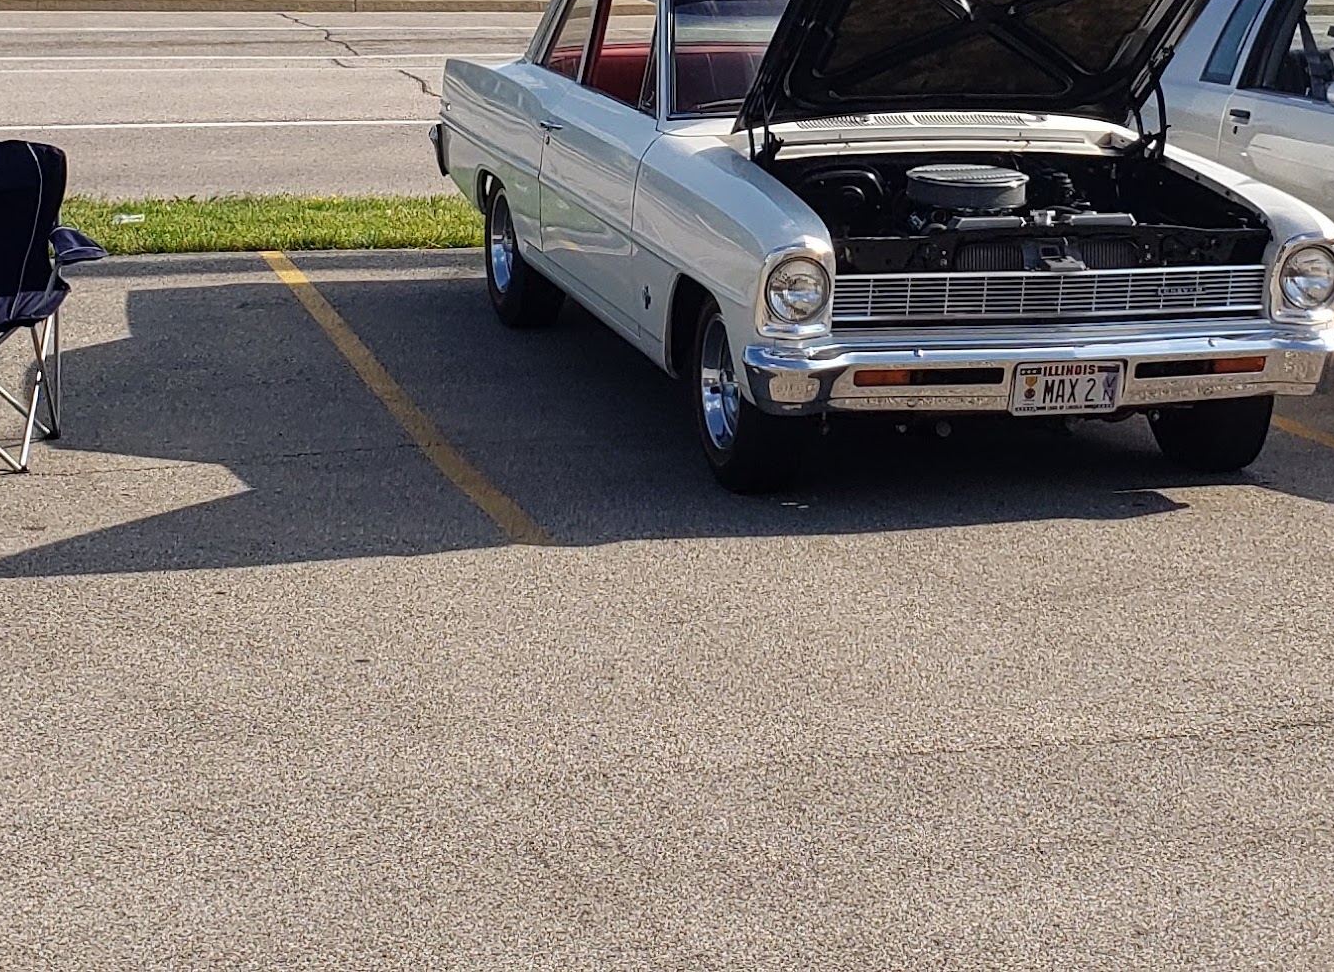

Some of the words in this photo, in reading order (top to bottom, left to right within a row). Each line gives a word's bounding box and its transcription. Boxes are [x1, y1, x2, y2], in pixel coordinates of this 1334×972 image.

[1043, 364, 1096, 377] ILLINOIS
[1042, 378, 1079, 404] MAX
[1085, 377, 1096, 402] 2
